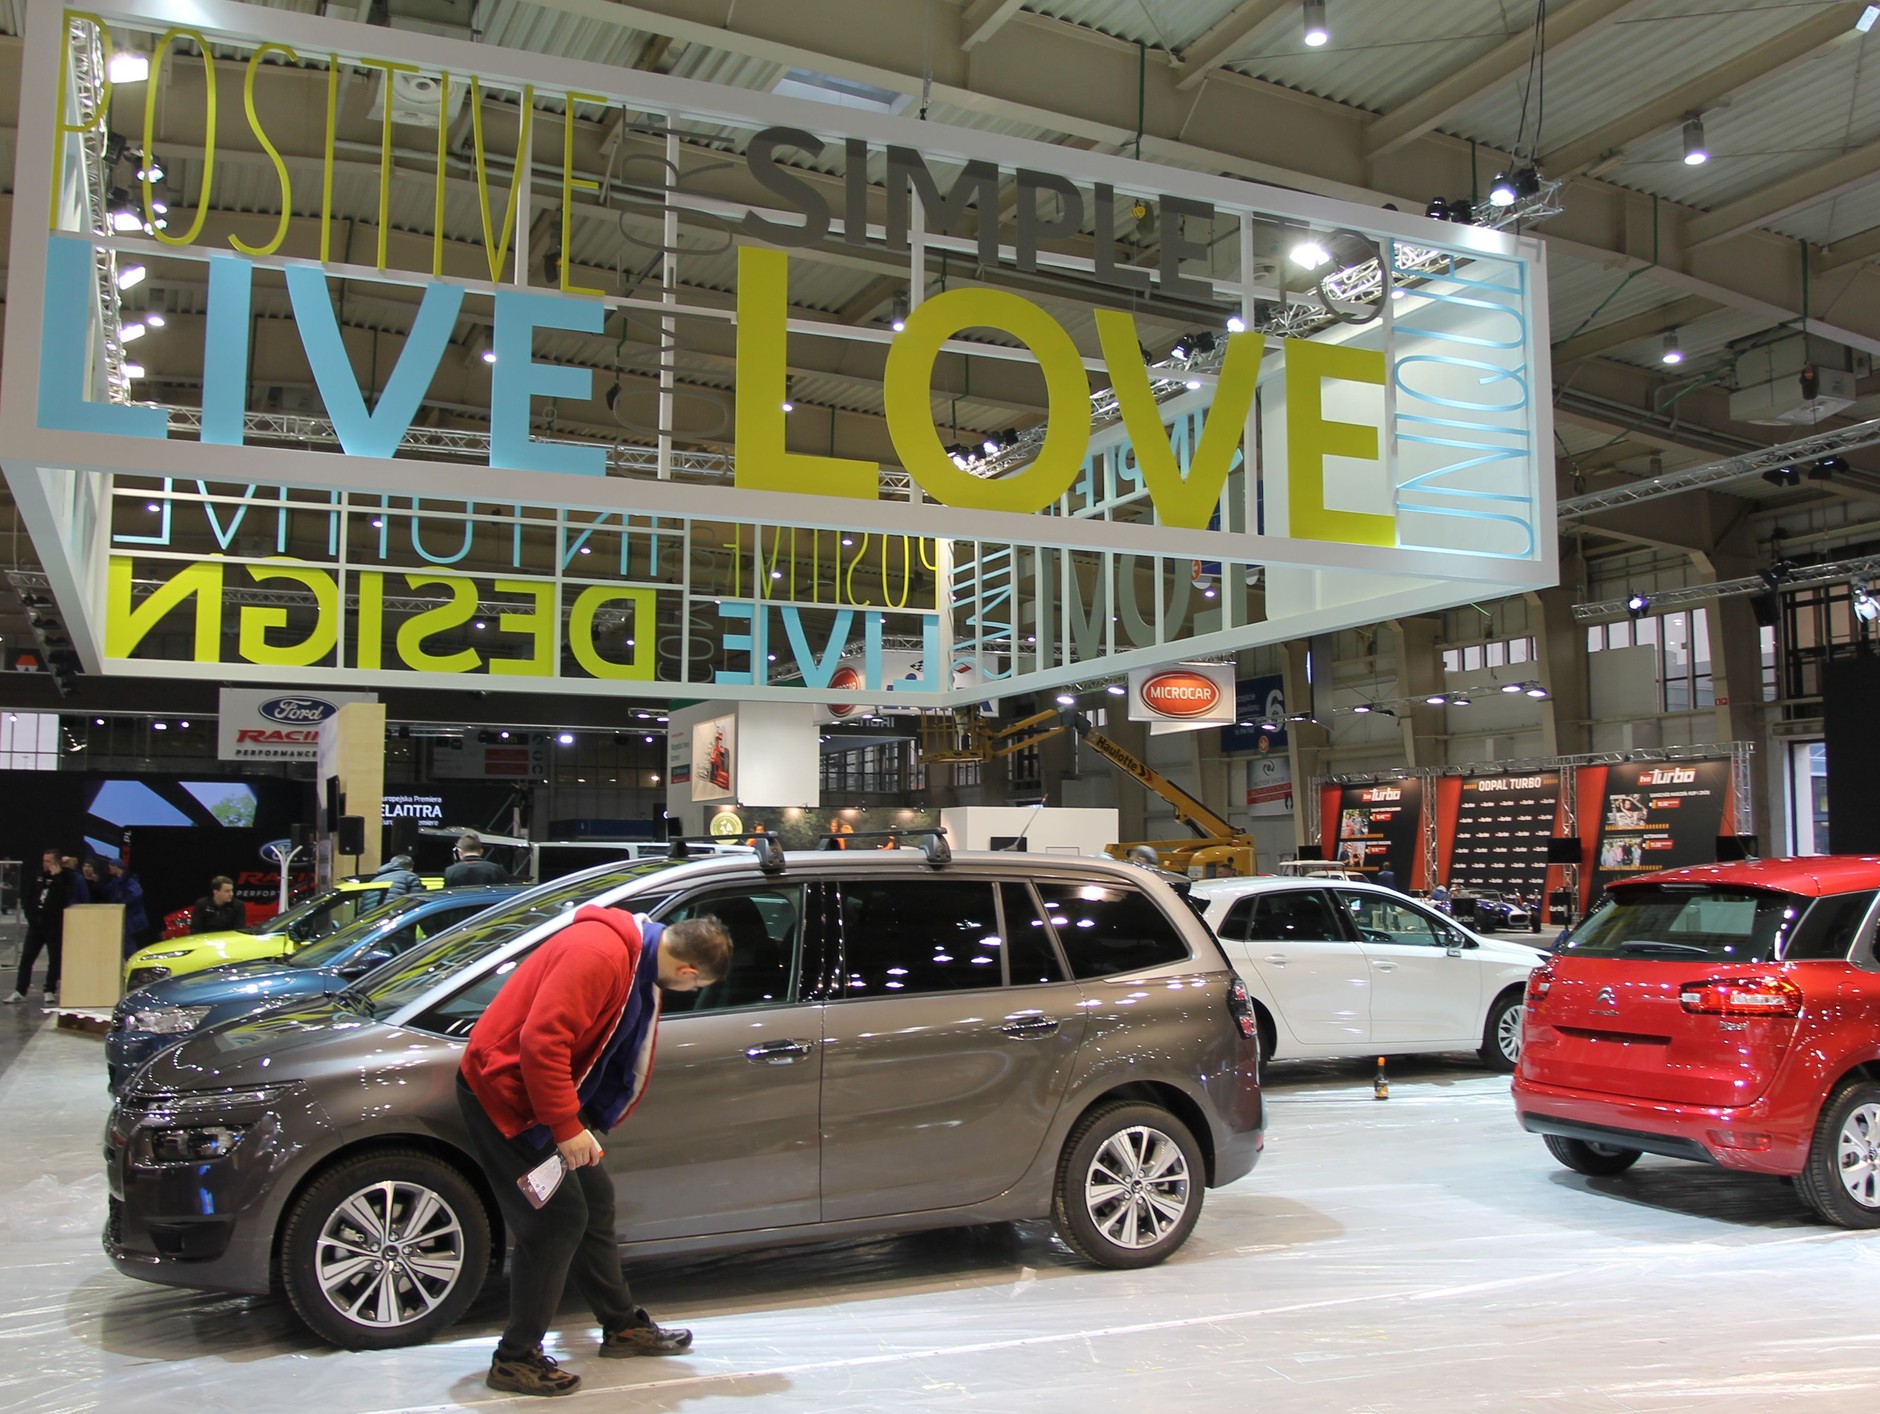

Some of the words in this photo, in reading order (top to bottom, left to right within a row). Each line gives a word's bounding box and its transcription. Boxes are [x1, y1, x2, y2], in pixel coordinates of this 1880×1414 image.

[50, 9, 608, 297] POSITIVE
[741, 126, 1215, 301] SIMPLE
[37, 236, 608, 477] LIVE
[735, 246, 1397, 547] LOVE
[1390, 237, 1537, 561] UNIQUE
[1150, 686, 1212, 701] MICROCAR
[274, 698, 325, 721] Ford
[237, 729, 319, 744] RACI
[1096, 736, 1139, 772] Haulotte
[1478, 779, 1509, 792] ODPAL
[1510, 777, 1542, 790] TURBO
[1649, 767, 1696, 785] turbo
[381, 795, 413, 804] uropejska
[1369, 787, 1402, 801] turbo
